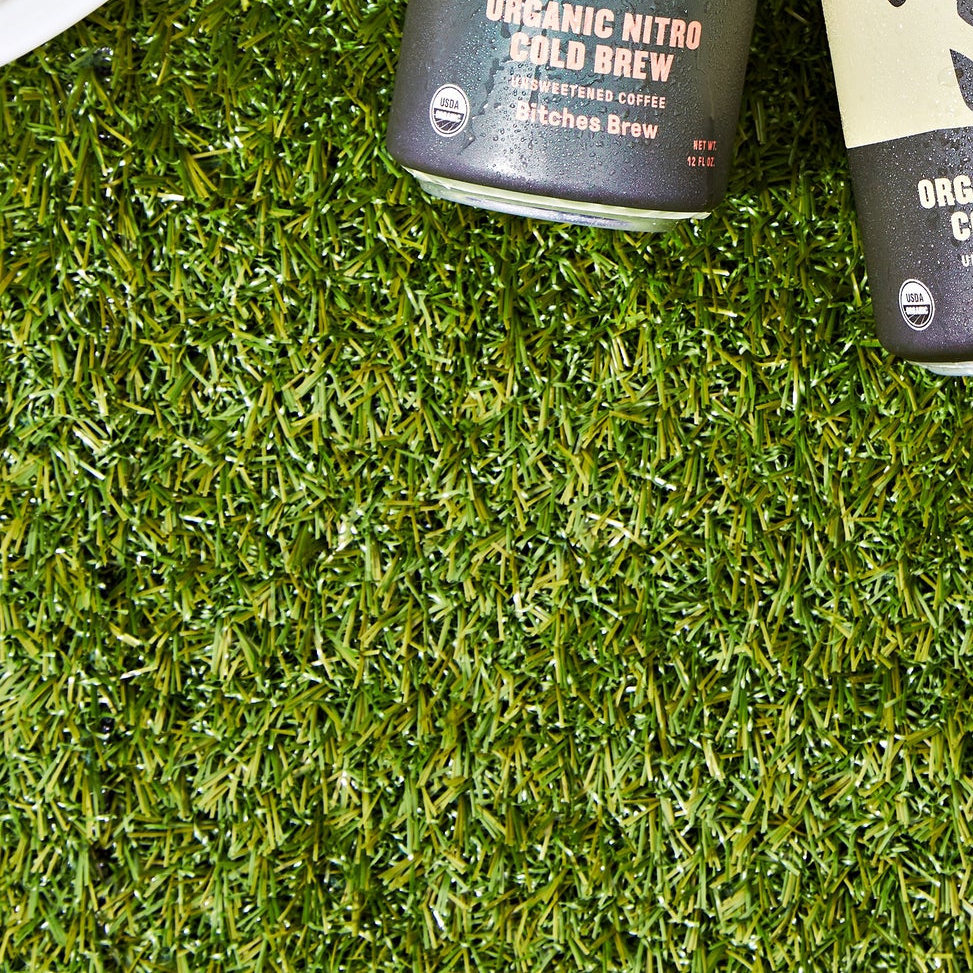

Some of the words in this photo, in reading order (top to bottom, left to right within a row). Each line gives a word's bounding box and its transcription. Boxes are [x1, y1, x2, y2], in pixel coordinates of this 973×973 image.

[622, 12, 702, 50] NITRO
[509, 32, 586, 71] COLD
[594, 44, 674, 82] BREW
[440, 97, 459, 109] USDA
[511, 76, 614, 103] UNSWEETENED
[618, 91, 666, 109] COFFEE
[515, 99, 601, 133] Bitches
[607, 113, 659, 140] Brew
[693, 139, 706, 150] NET
[687, 156, 696, 166] 12
[698, 156, 705, 166] FL
[905, 292, 924, 303] USDA
